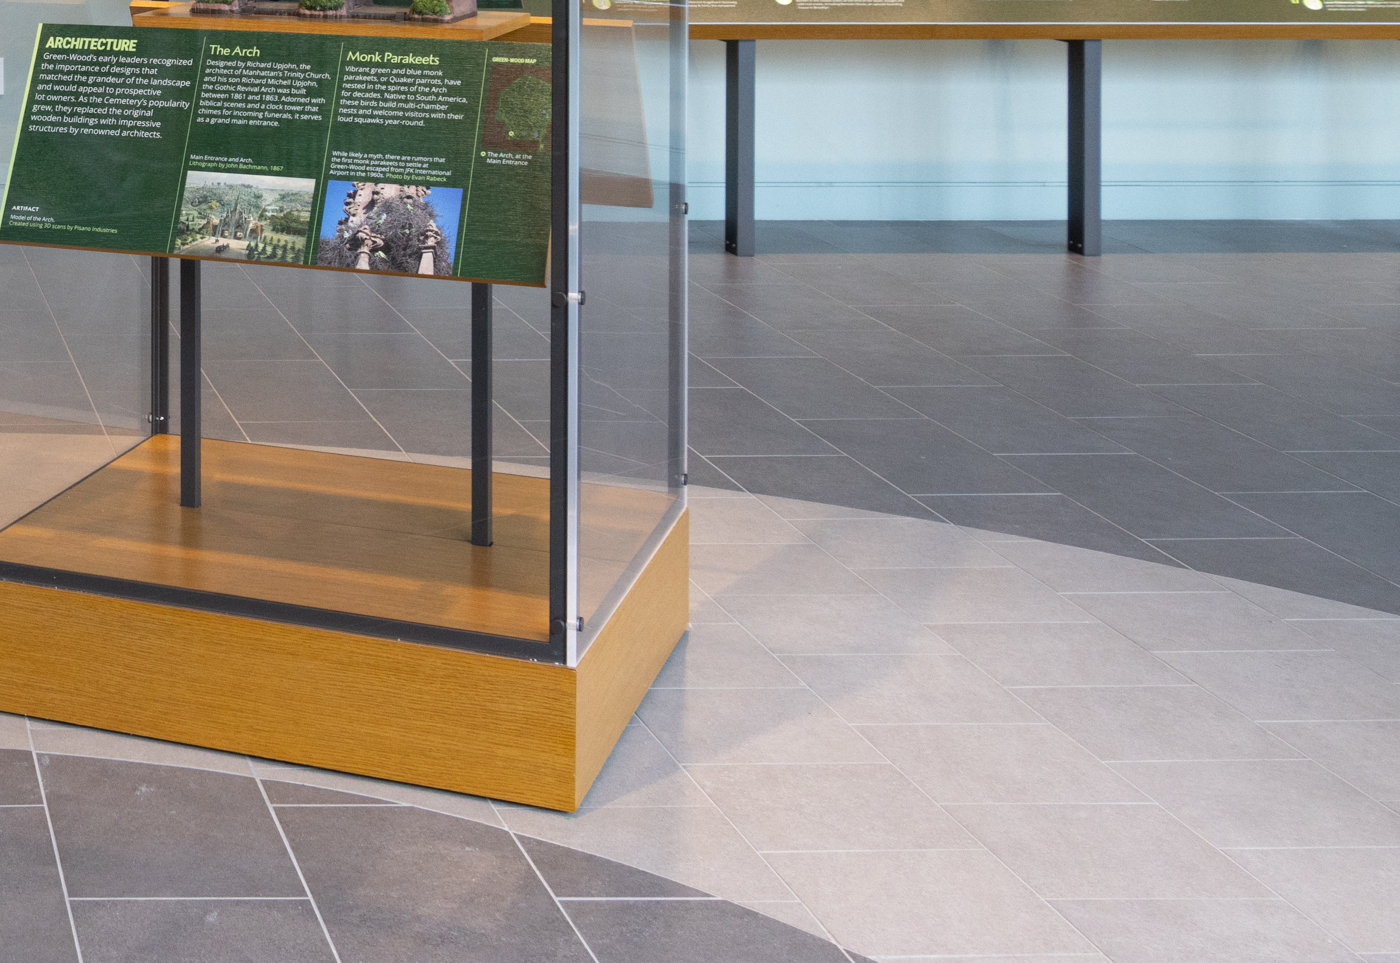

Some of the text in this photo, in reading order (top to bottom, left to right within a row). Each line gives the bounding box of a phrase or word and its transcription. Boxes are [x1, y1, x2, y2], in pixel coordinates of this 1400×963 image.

[46, 37, 137, 51] ARCHITECTURE
[210, 45, 260, 57] The Arch
[44, 53, 97, 62] Green-Wood's
[99, 55, 118, 66] early
[150, 58, 193, 67] recognized
[347, 52, 439, 65] Monk Parakeets
[56, 64, 100, 72] importance
[110, 66, 140, 75] designs
[238, 61, 246, 69] by
[273, 63, 298, 72] Upjohn,
[284, 71, 305, 79] Trinity
[344, 75, 378, 84] parakeets,
[150, 78, 191, 88] landscape
[104, 97, 147, 107] Cemetery's
[149, 100, 190, 110] popularity
[55, 105, 73, 114] they
[124, 109, 154, 118] original
[63, 116, 98, 126] buildings
[119, 119, 161, 128] impressive
[69, 126, 80, 136] by
[122, 130, 162, 138] architects.
